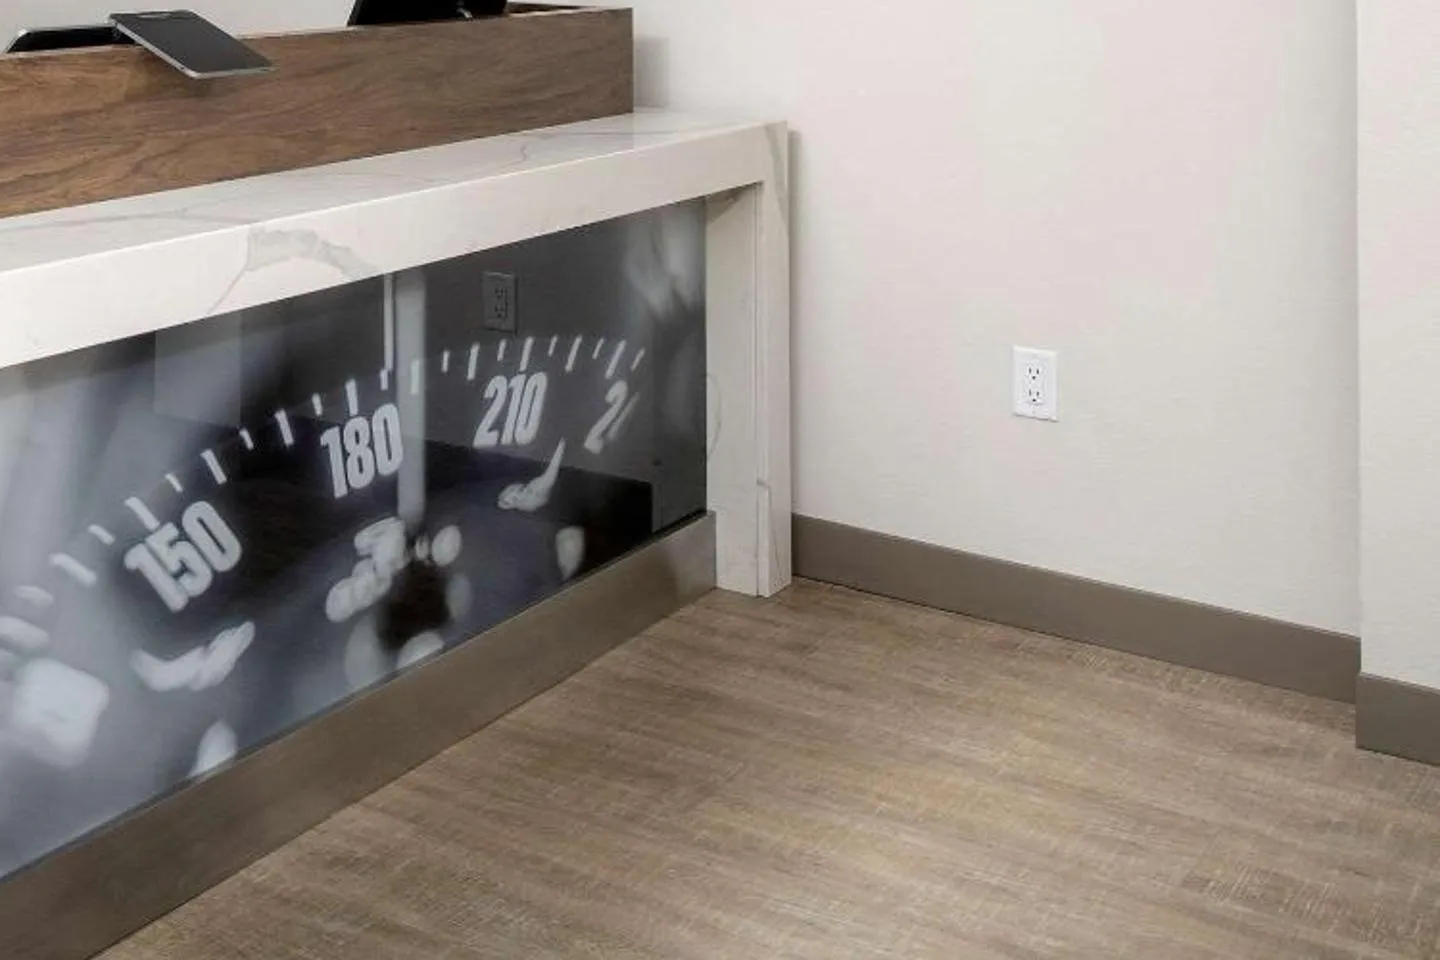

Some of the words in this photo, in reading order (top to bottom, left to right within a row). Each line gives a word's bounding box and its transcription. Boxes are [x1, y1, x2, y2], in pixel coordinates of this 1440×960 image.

[320, 403, 403, 498] 180
[473, 371, 547, 448] 210
[123, 500, 242, 613] 150
